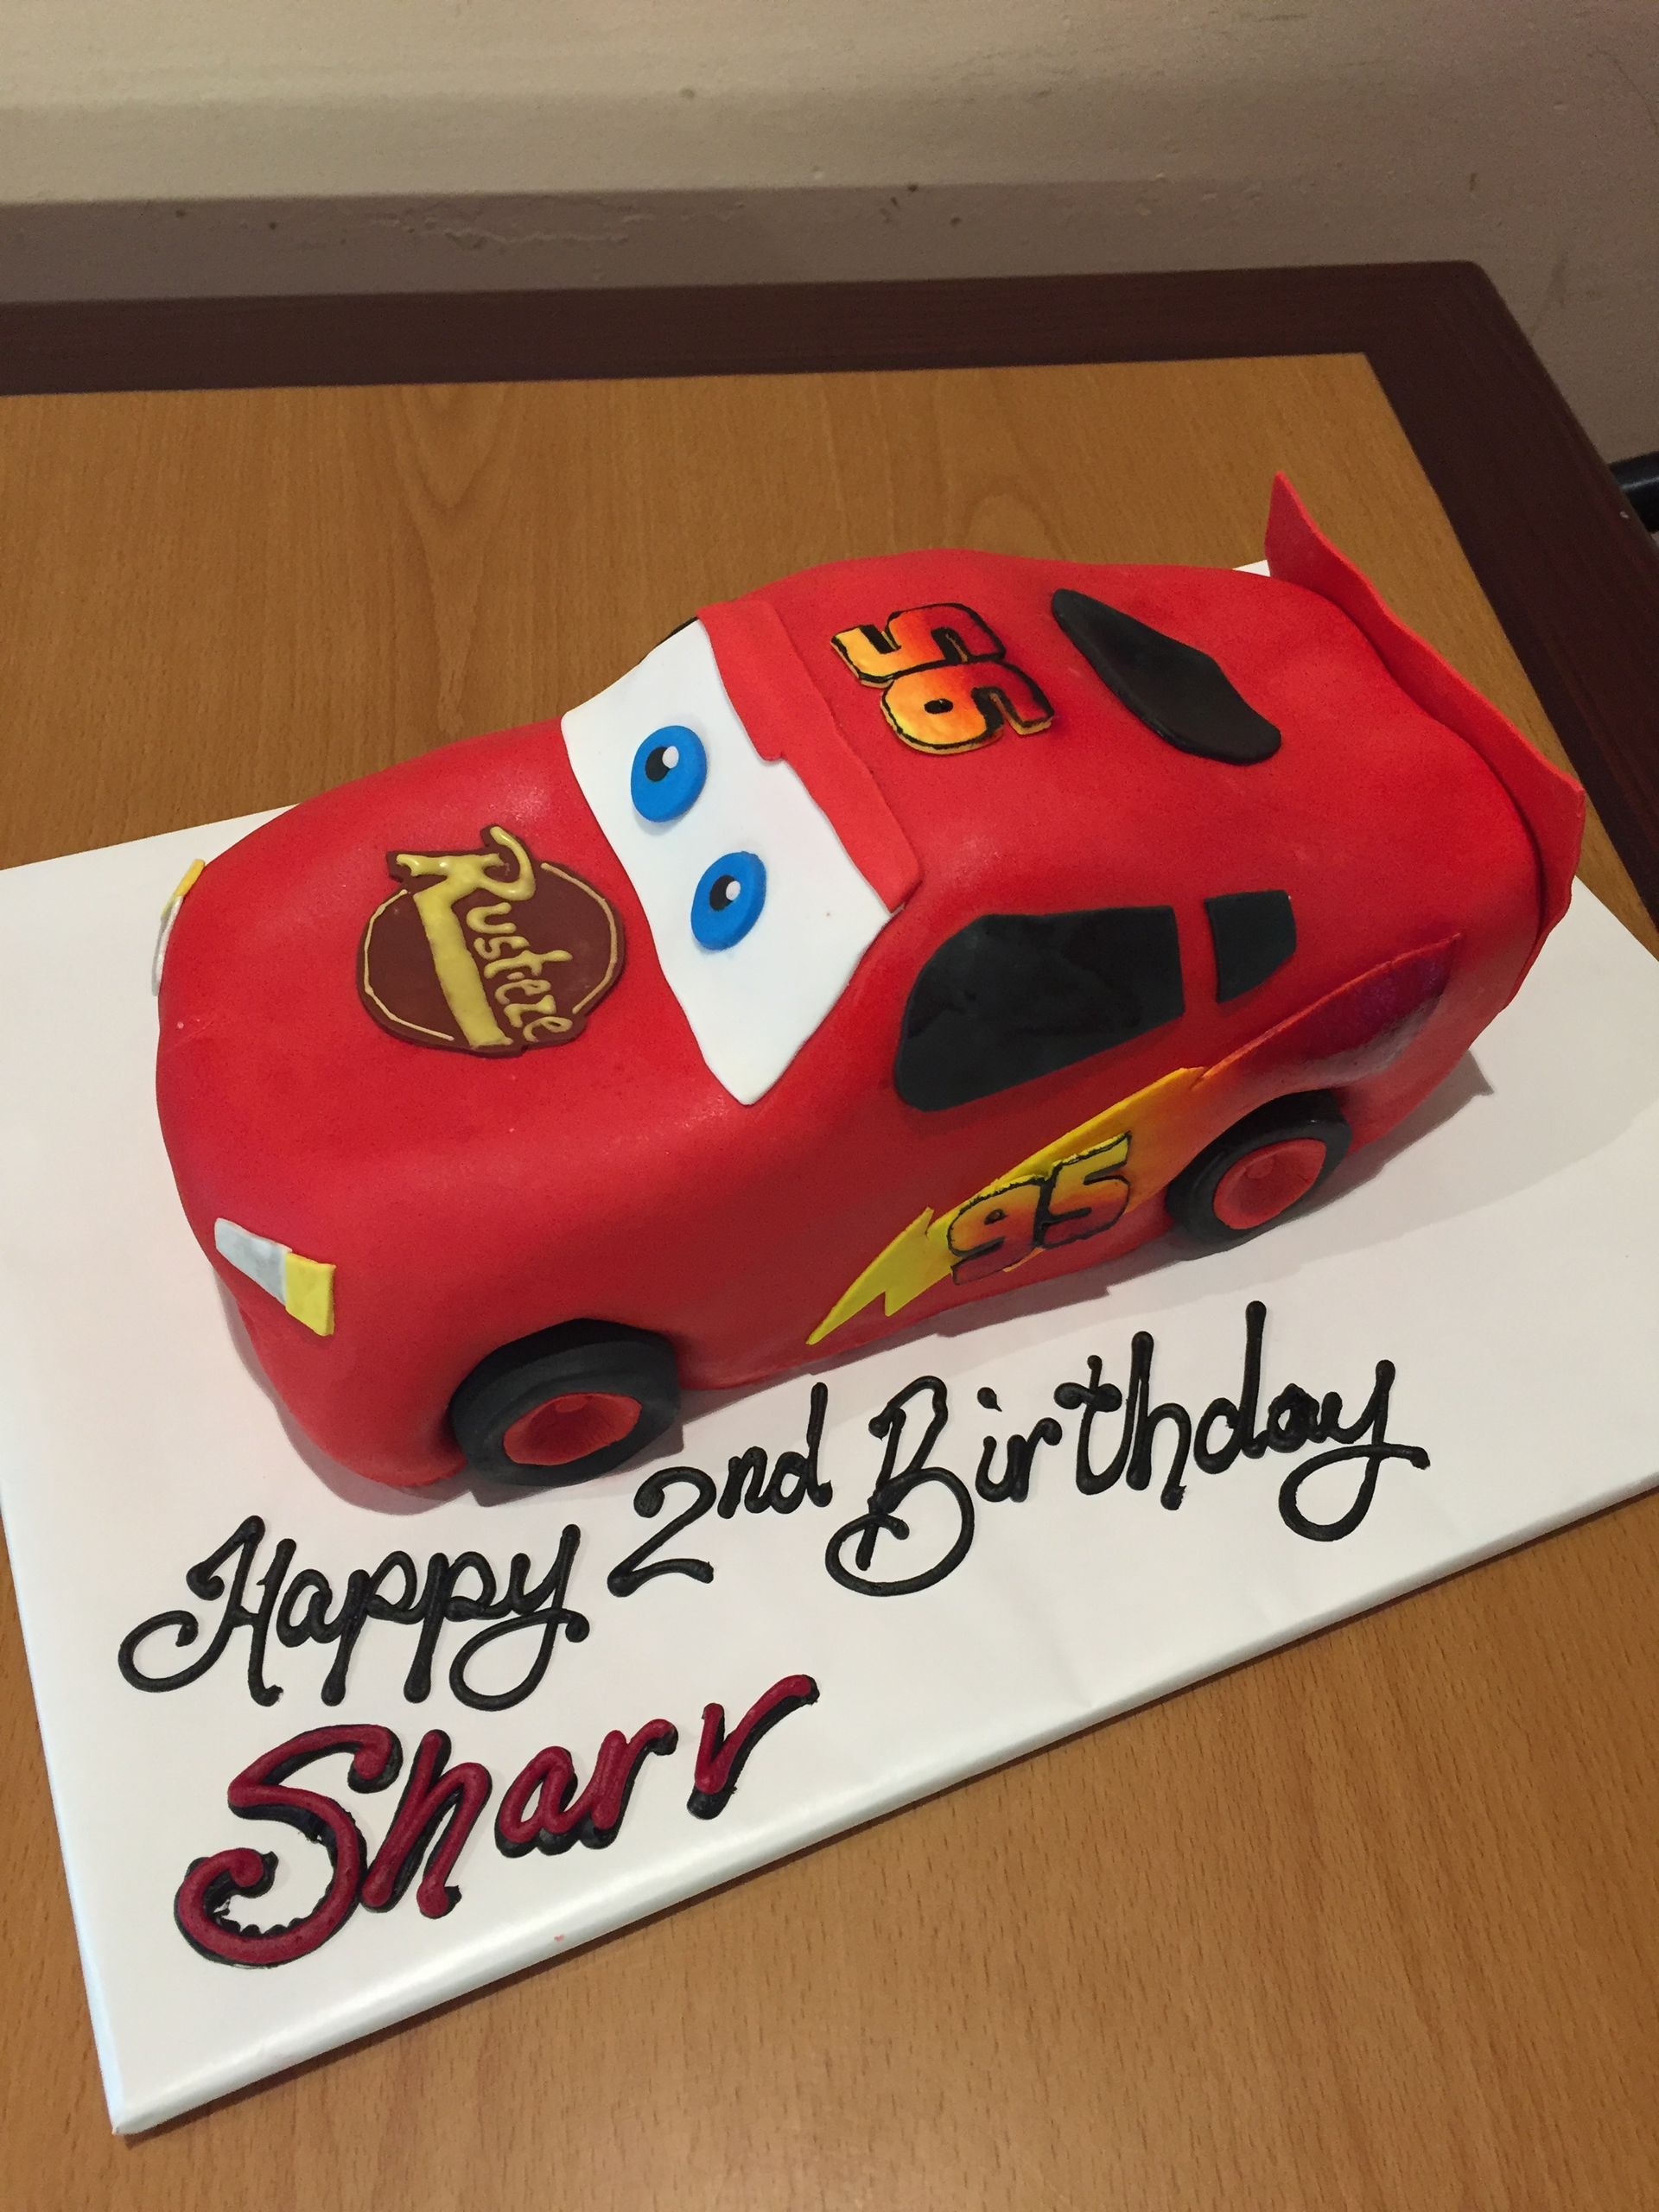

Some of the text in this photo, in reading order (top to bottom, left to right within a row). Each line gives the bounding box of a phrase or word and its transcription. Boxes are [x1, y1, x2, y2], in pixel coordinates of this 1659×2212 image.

[946, 1130, 1132, 1287] 95
[118, 1301, 1430, 1712] Happy 2nd Birthday
[175, 1675, 819, 1969] Sharv
